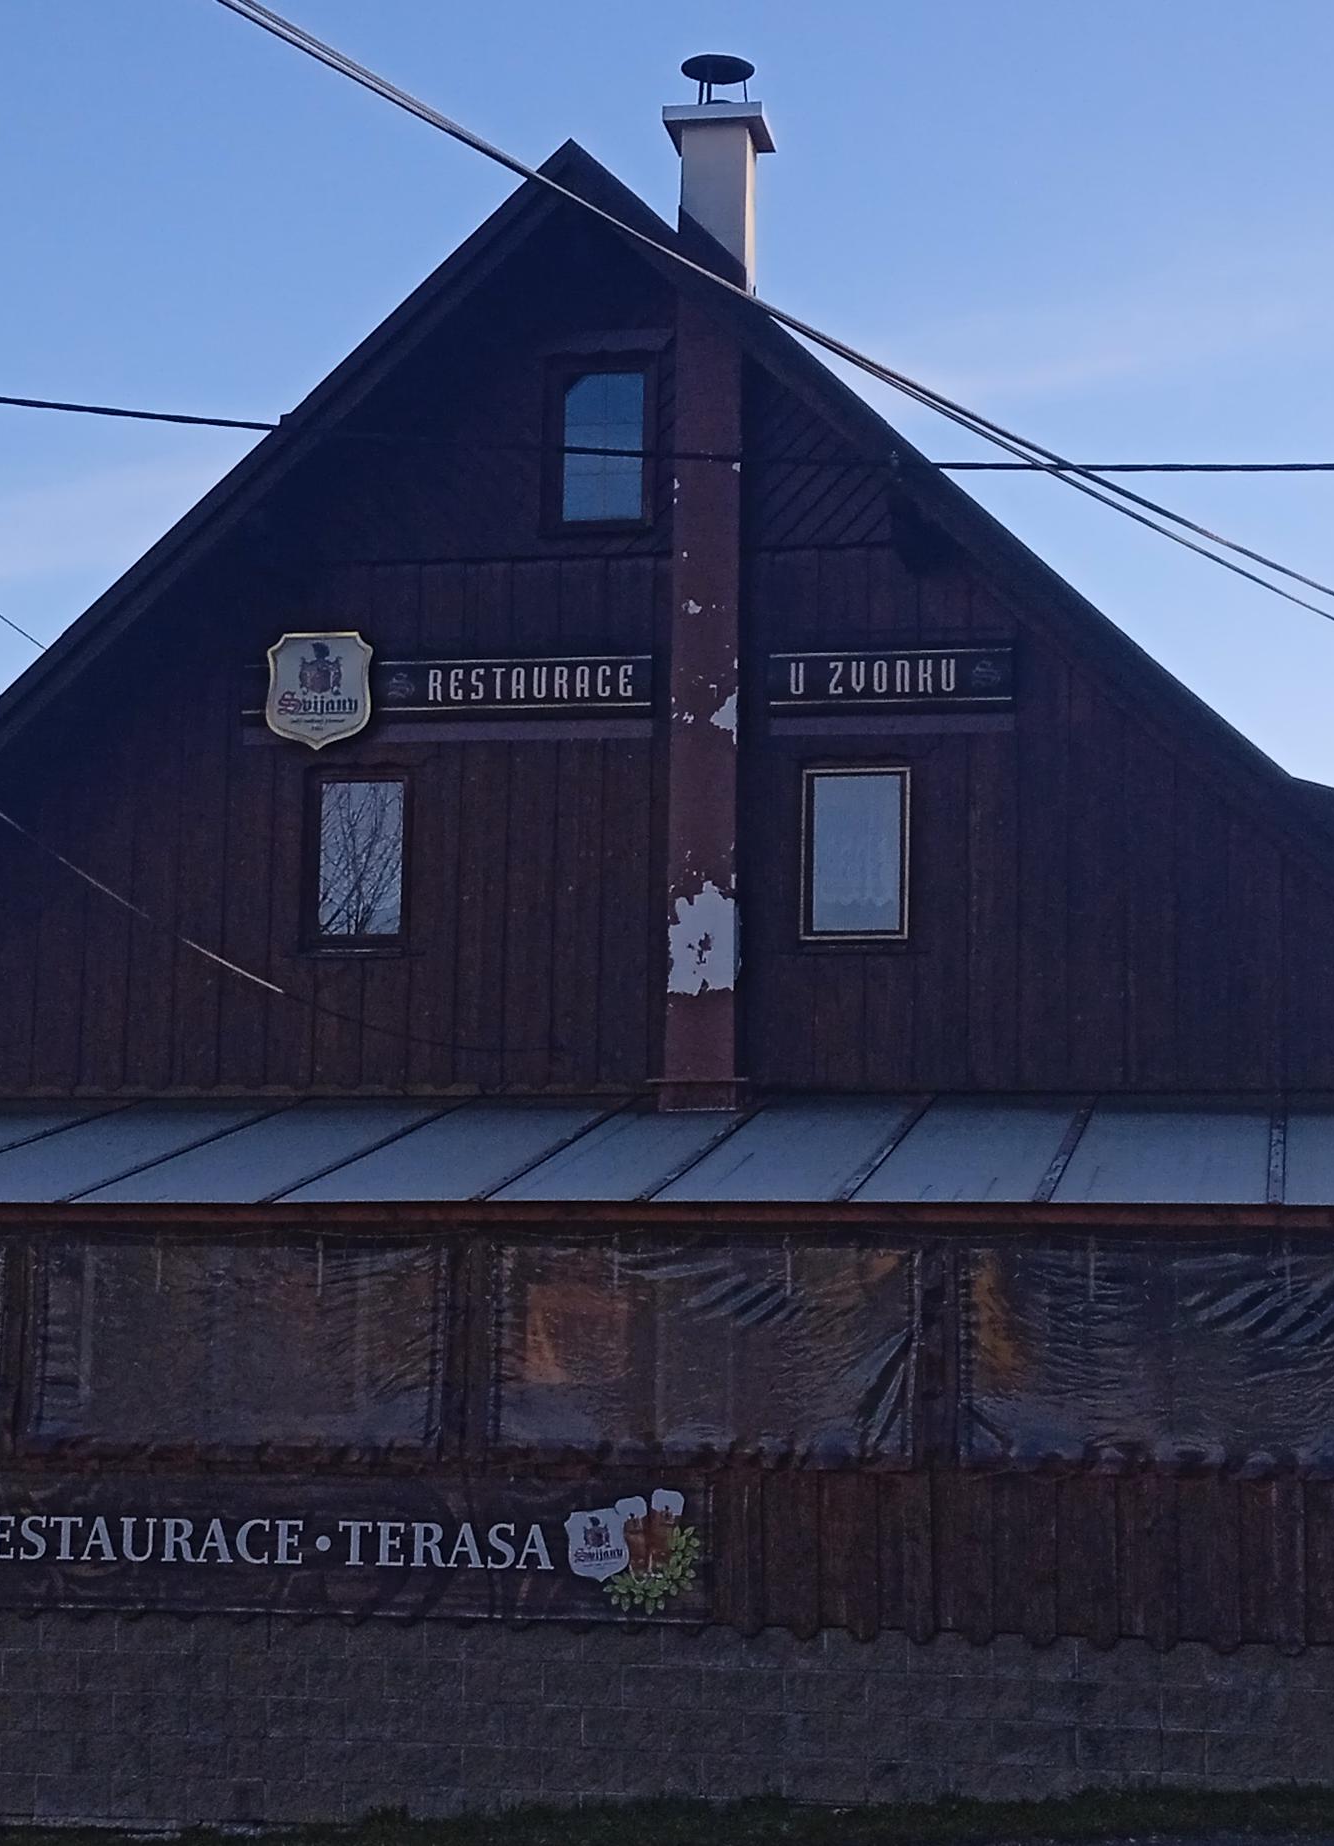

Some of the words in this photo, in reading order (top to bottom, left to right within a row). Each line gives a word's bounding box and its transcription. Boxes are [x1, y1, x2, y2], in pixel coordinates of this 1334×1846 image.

[427, 664, 634, 702] RESTAURACE
[789, 662, 804, 695] U
[828, 658, 956, 695] ZVONKU
[277, 690, 359, 716] Svijany
[338, 1520, 556, 1571] TERASA
